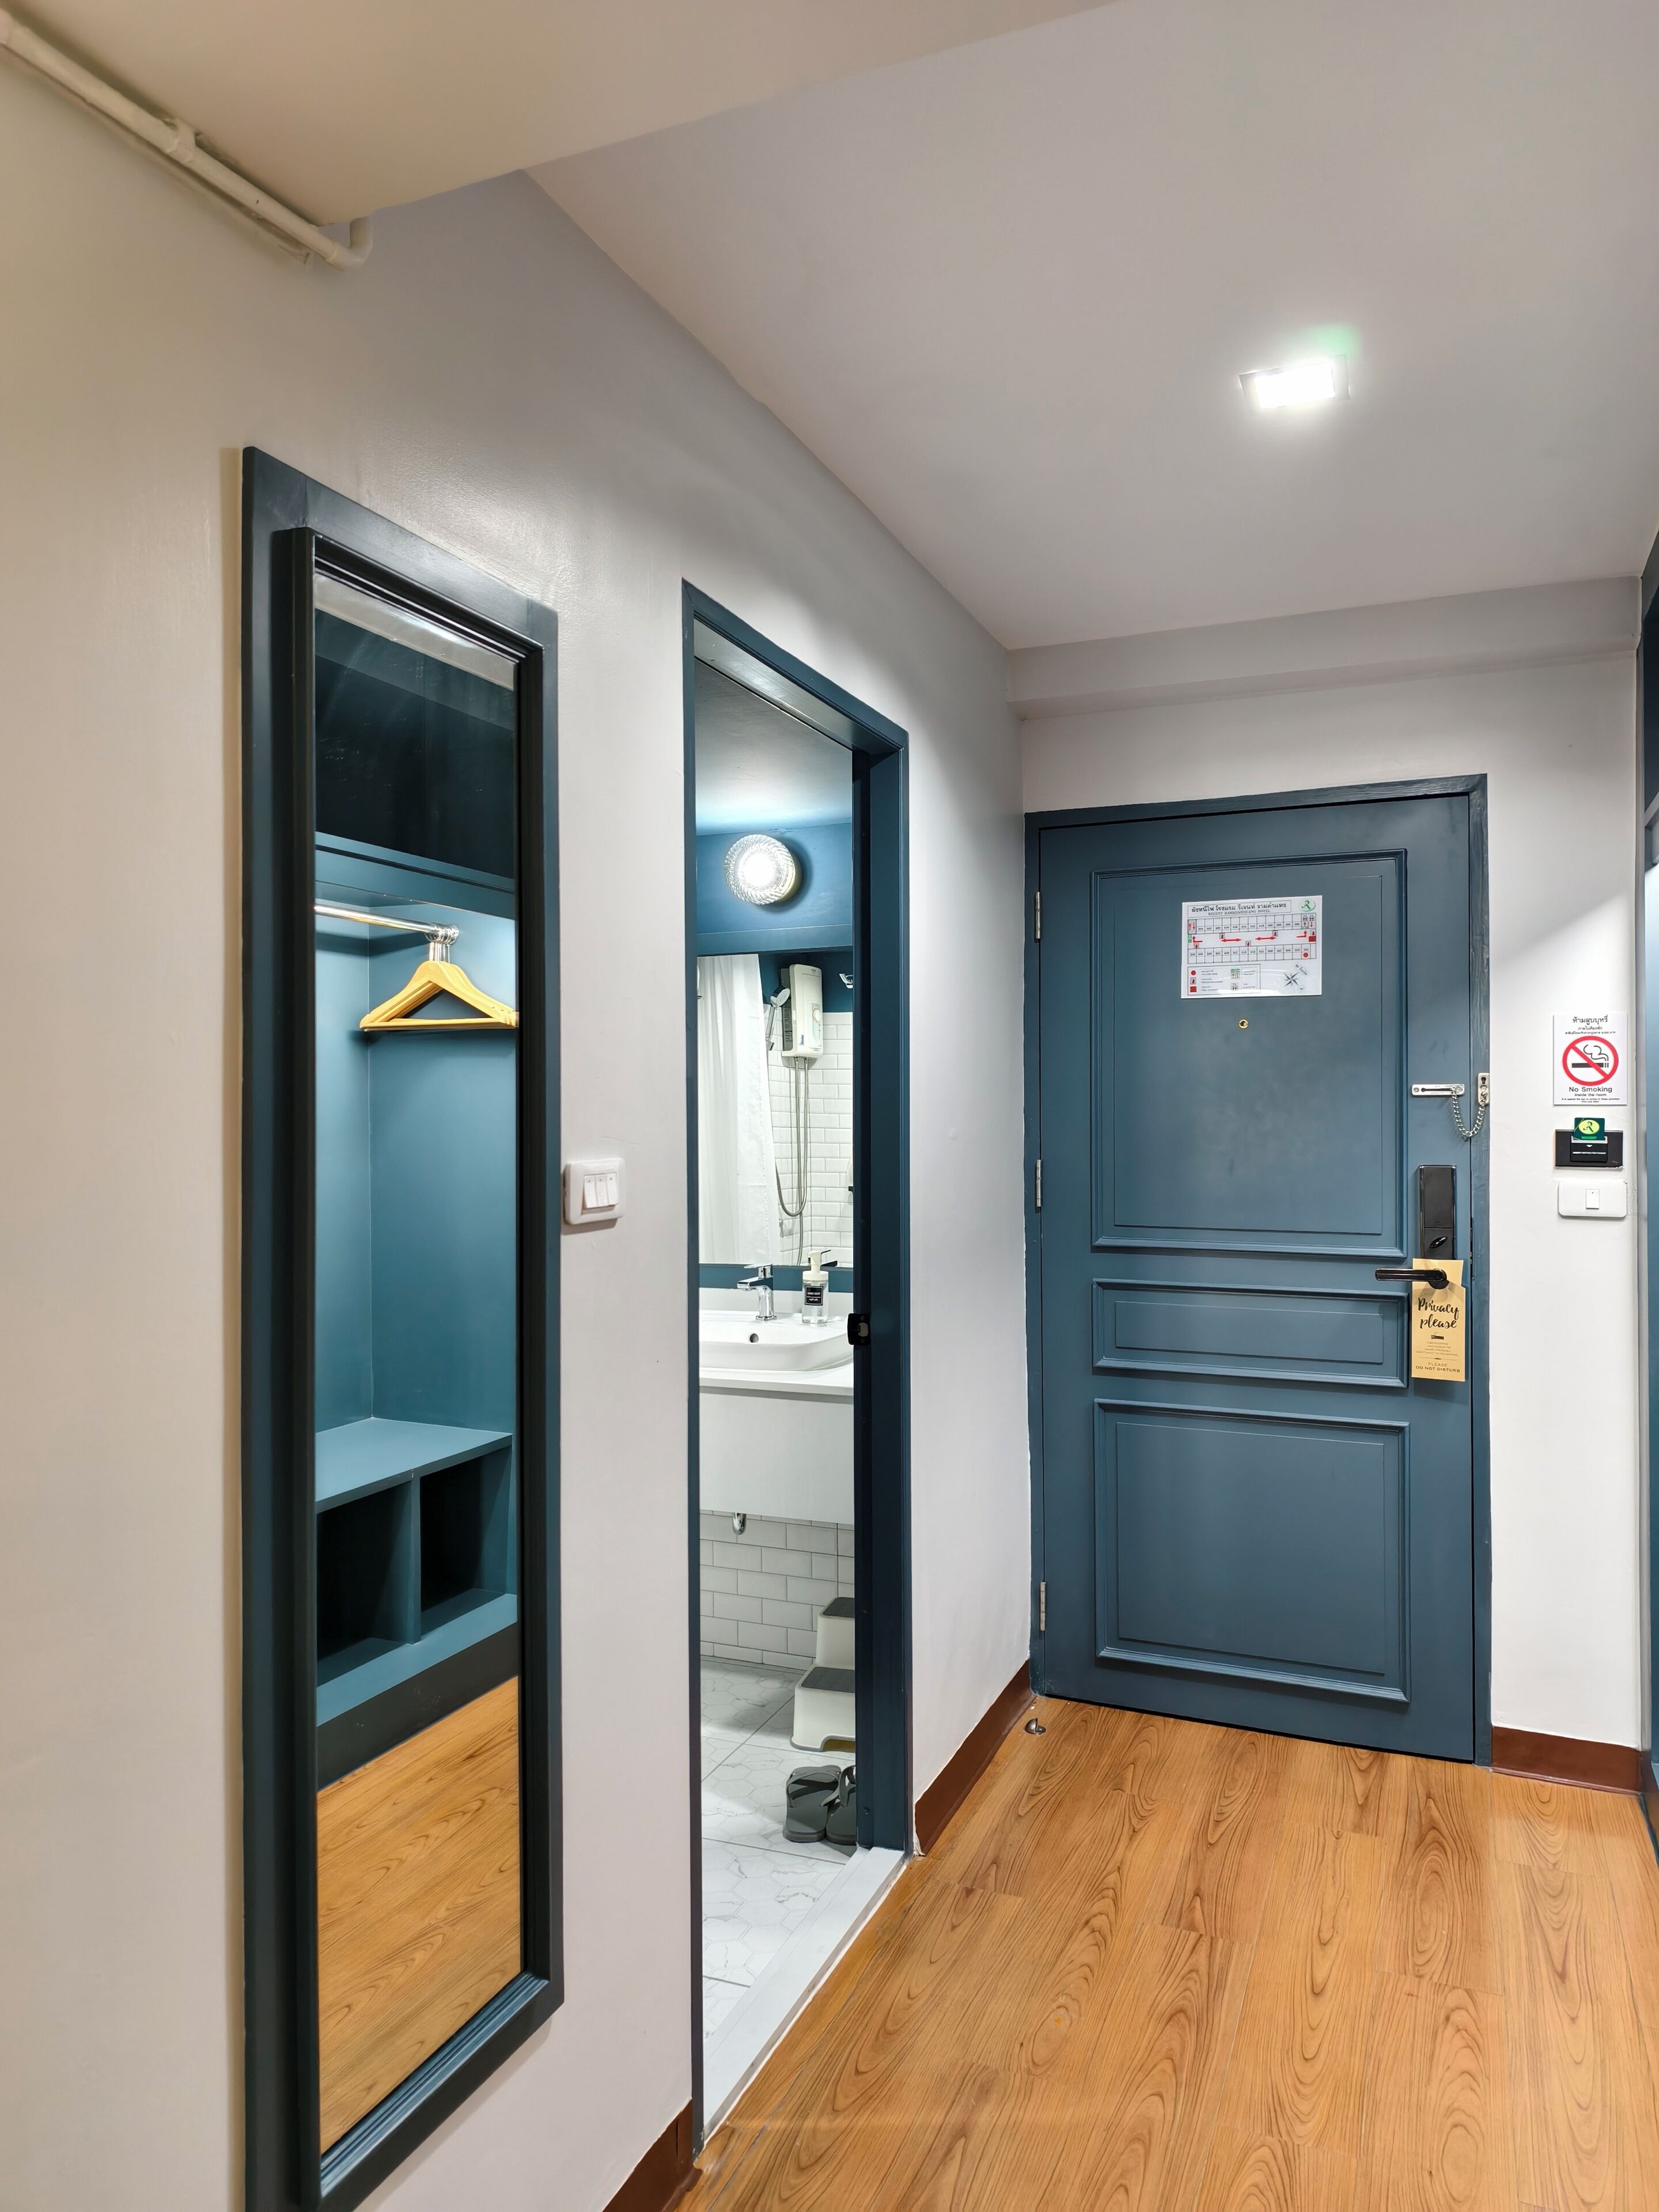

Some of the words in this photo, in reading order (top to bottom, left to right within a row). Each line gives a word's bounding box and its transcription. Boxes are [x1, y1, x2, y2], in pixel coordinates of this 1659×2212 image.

[1572, 1014, 1608, 1025] ห้ามสูบบุหรี่
[1418, 1297, 1460, 1320] Privacy
[1419, 1314, 1457, 1329] please
